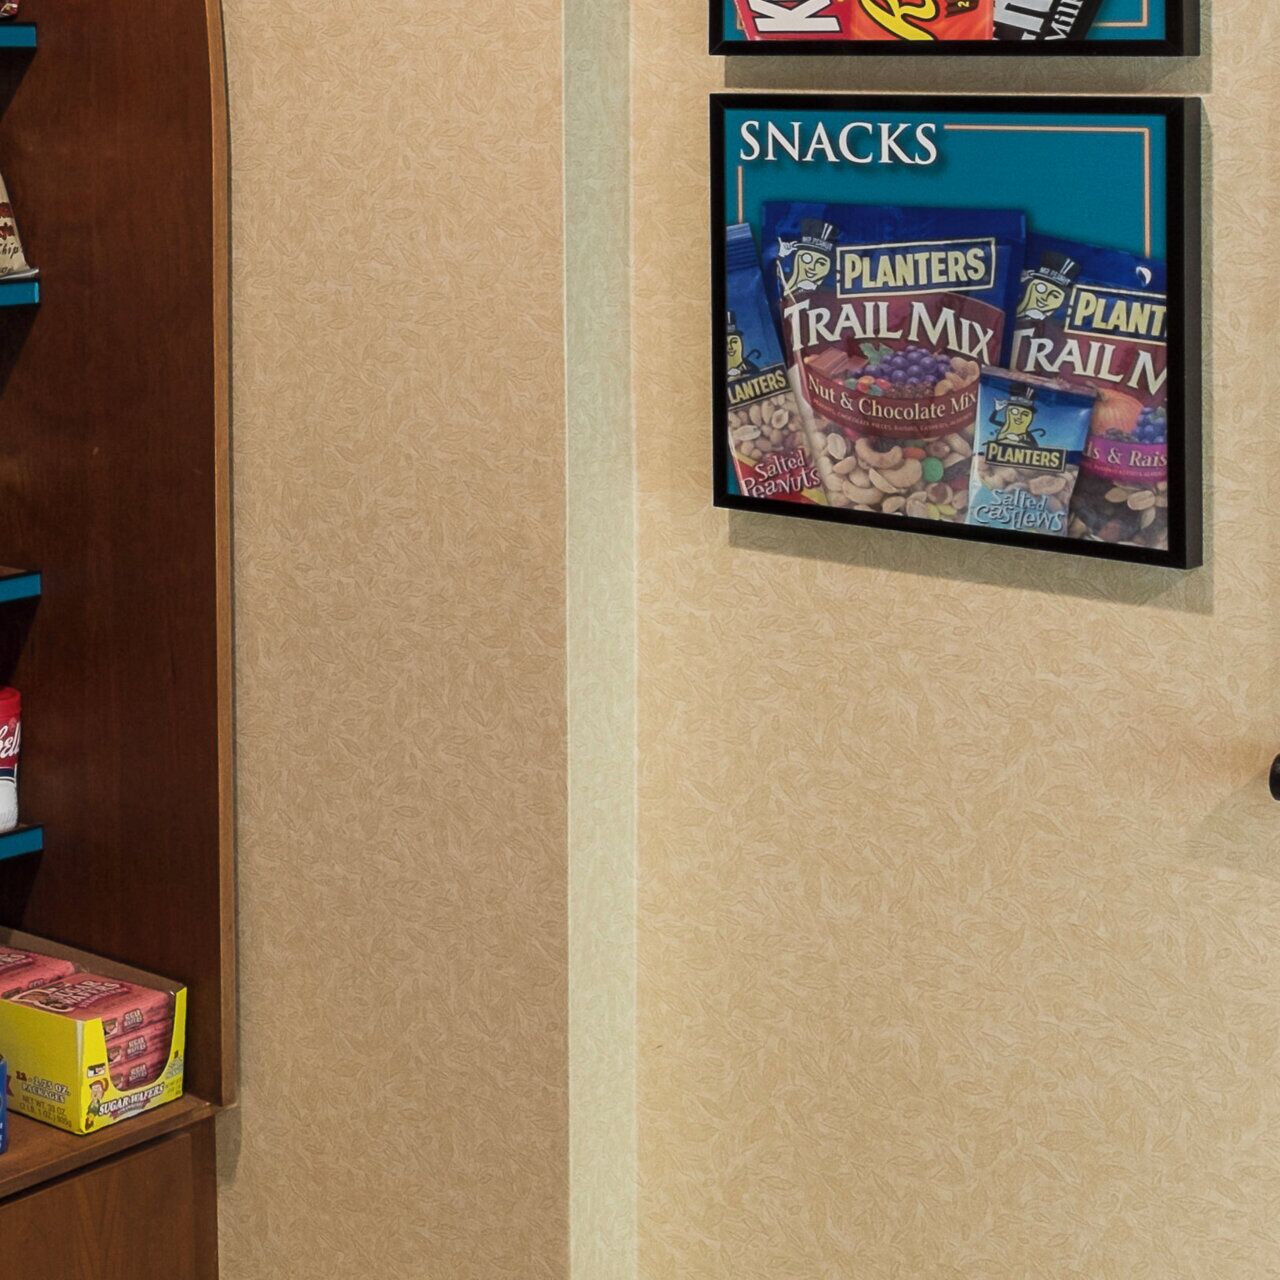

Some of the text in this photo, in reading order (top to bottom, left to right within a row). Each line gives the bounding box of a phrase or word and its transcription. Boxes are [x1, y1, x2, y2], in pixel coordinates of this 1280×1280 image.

[959, 0, 970, 8] 2
[739, 120, 938, 165] SNACKS
[843, 247, 986, 290] PLANTERS
[784, 301, 996, 368] TRAIL MIX
[807, 374, 978, 422] Nut & Chocolate Mix
[755, 449, 807, 480] Salted
[987, 442, 1060, 468] PLANTERS
